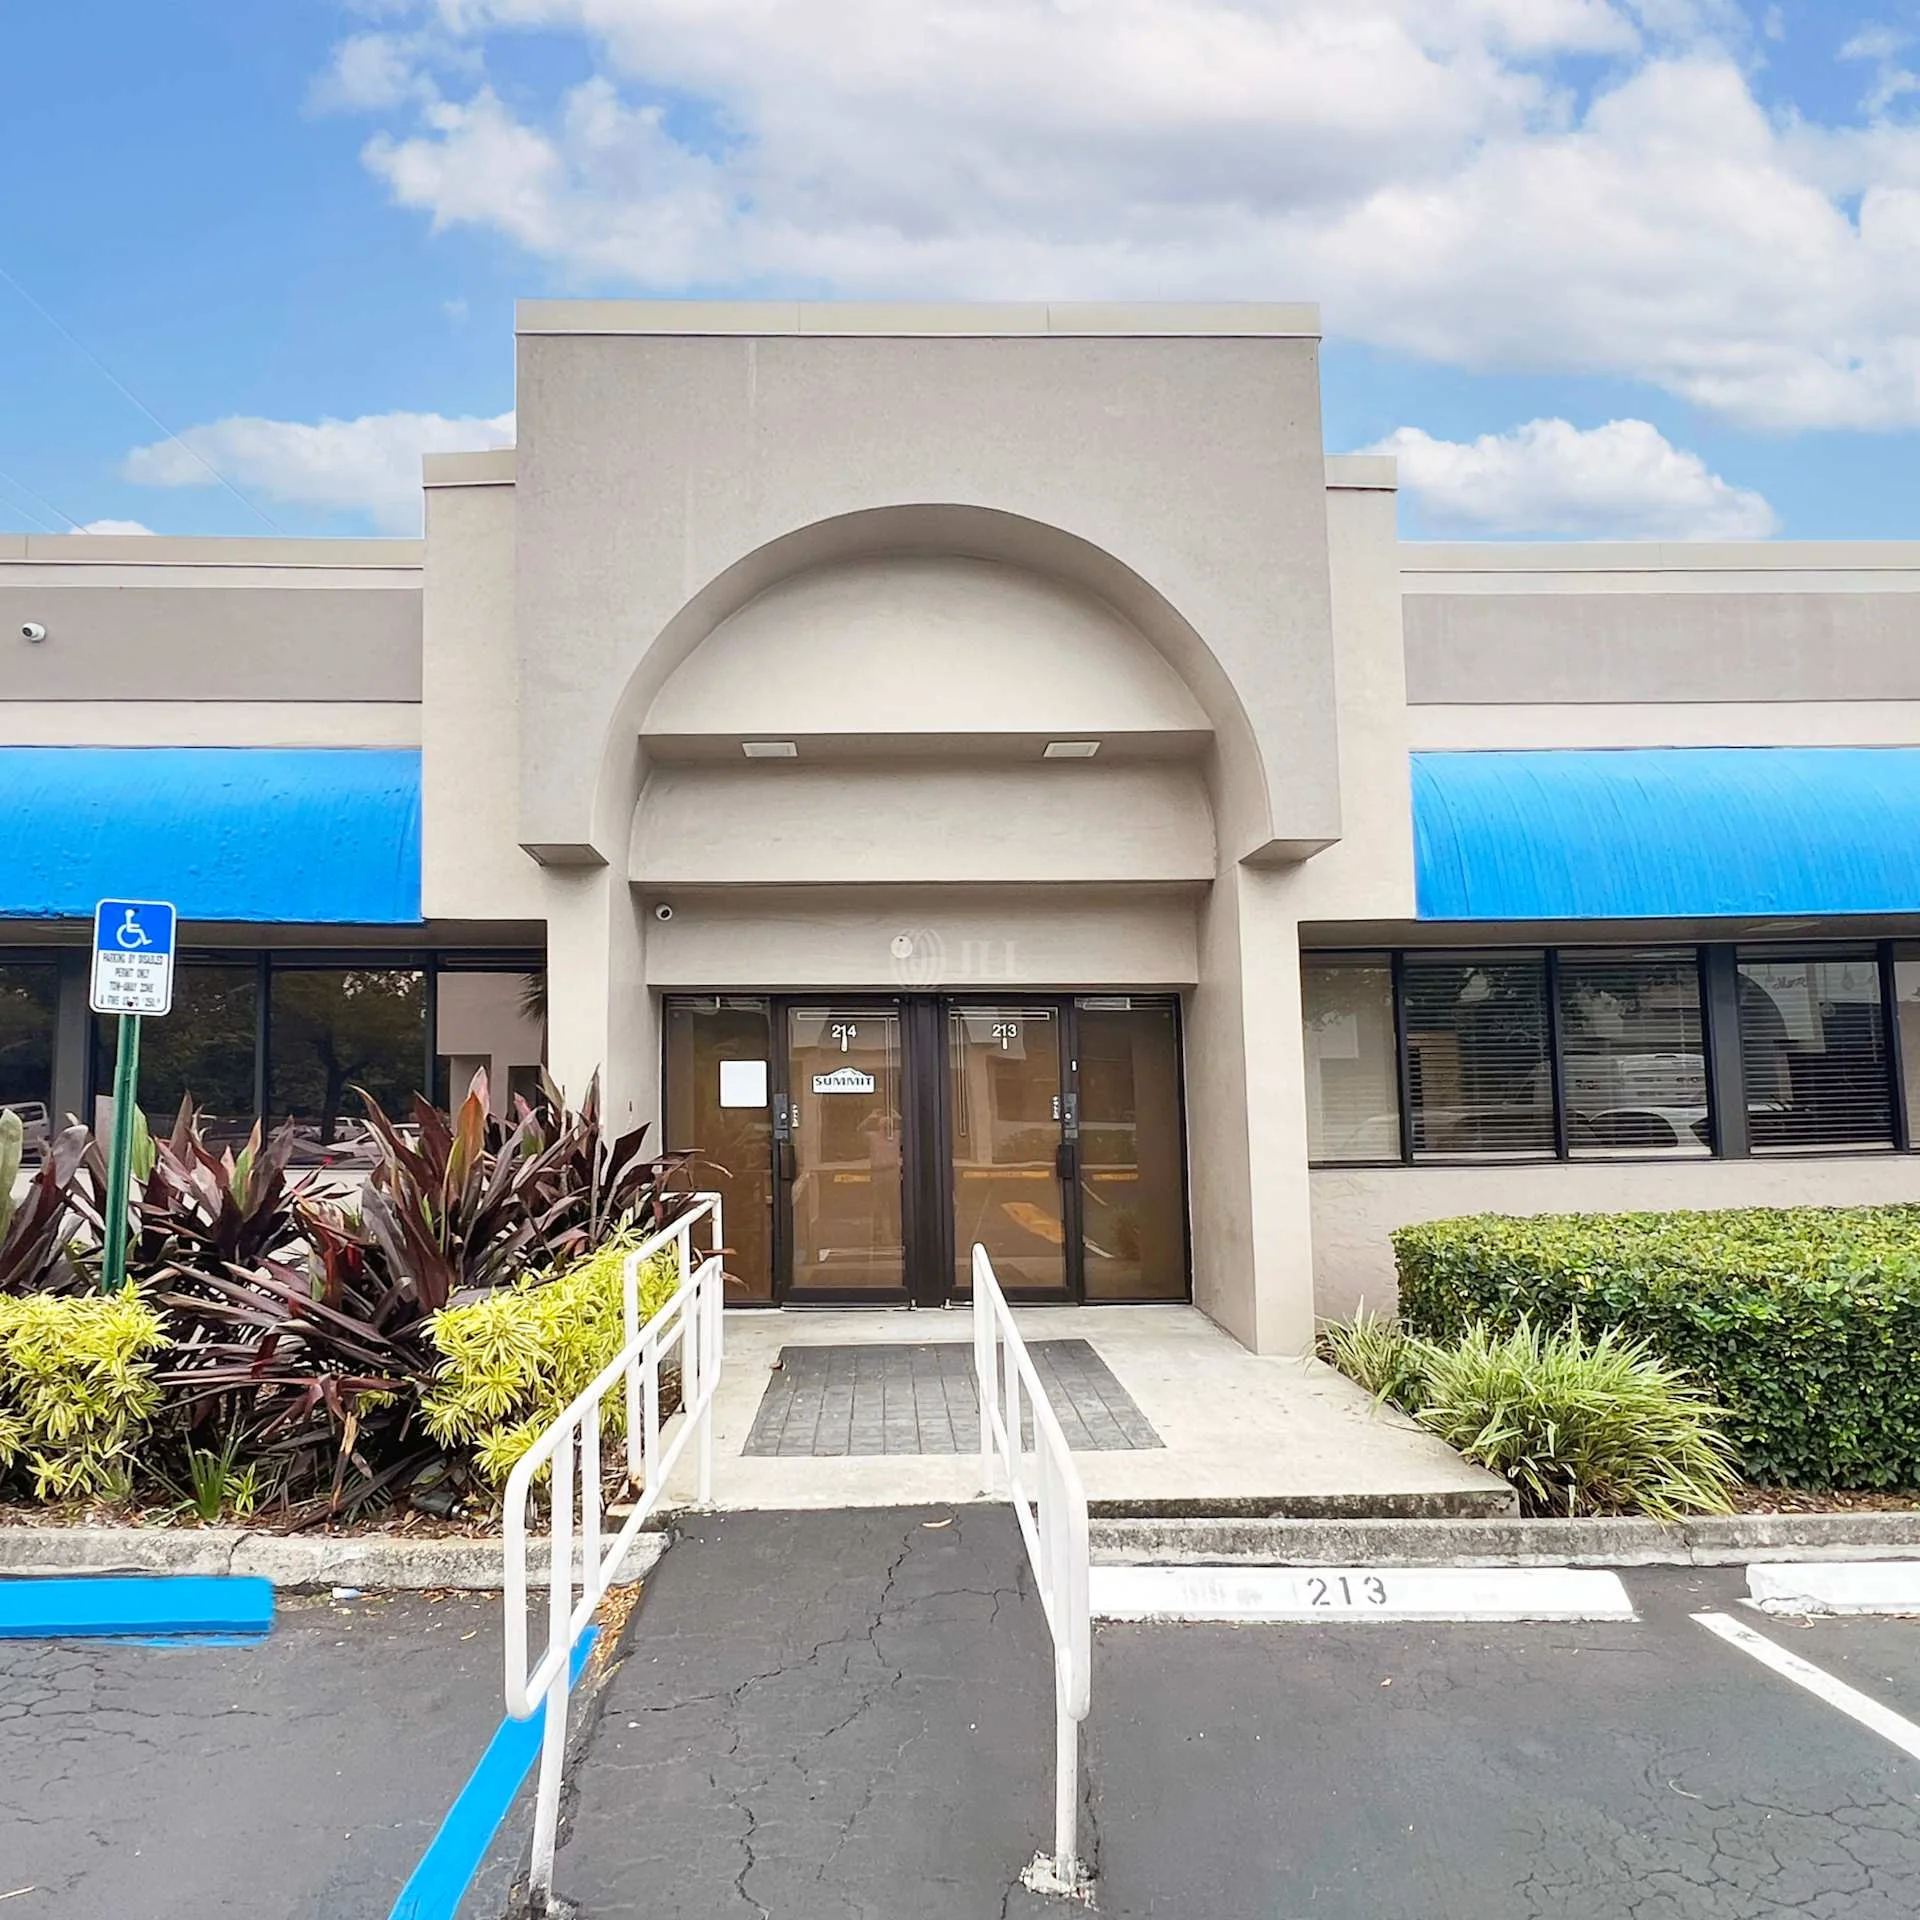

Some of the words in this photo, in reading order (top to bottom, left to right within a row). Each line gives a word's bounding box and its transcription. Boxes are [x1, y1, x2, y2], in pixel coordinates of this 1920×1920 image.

[831, 1025, 856, 1037] 214
[992, 1024, 1017, 1037] 213
[815, 1077, 871, 1085] SUMMIT
[1307, 1576, 1387, 1606] 213
